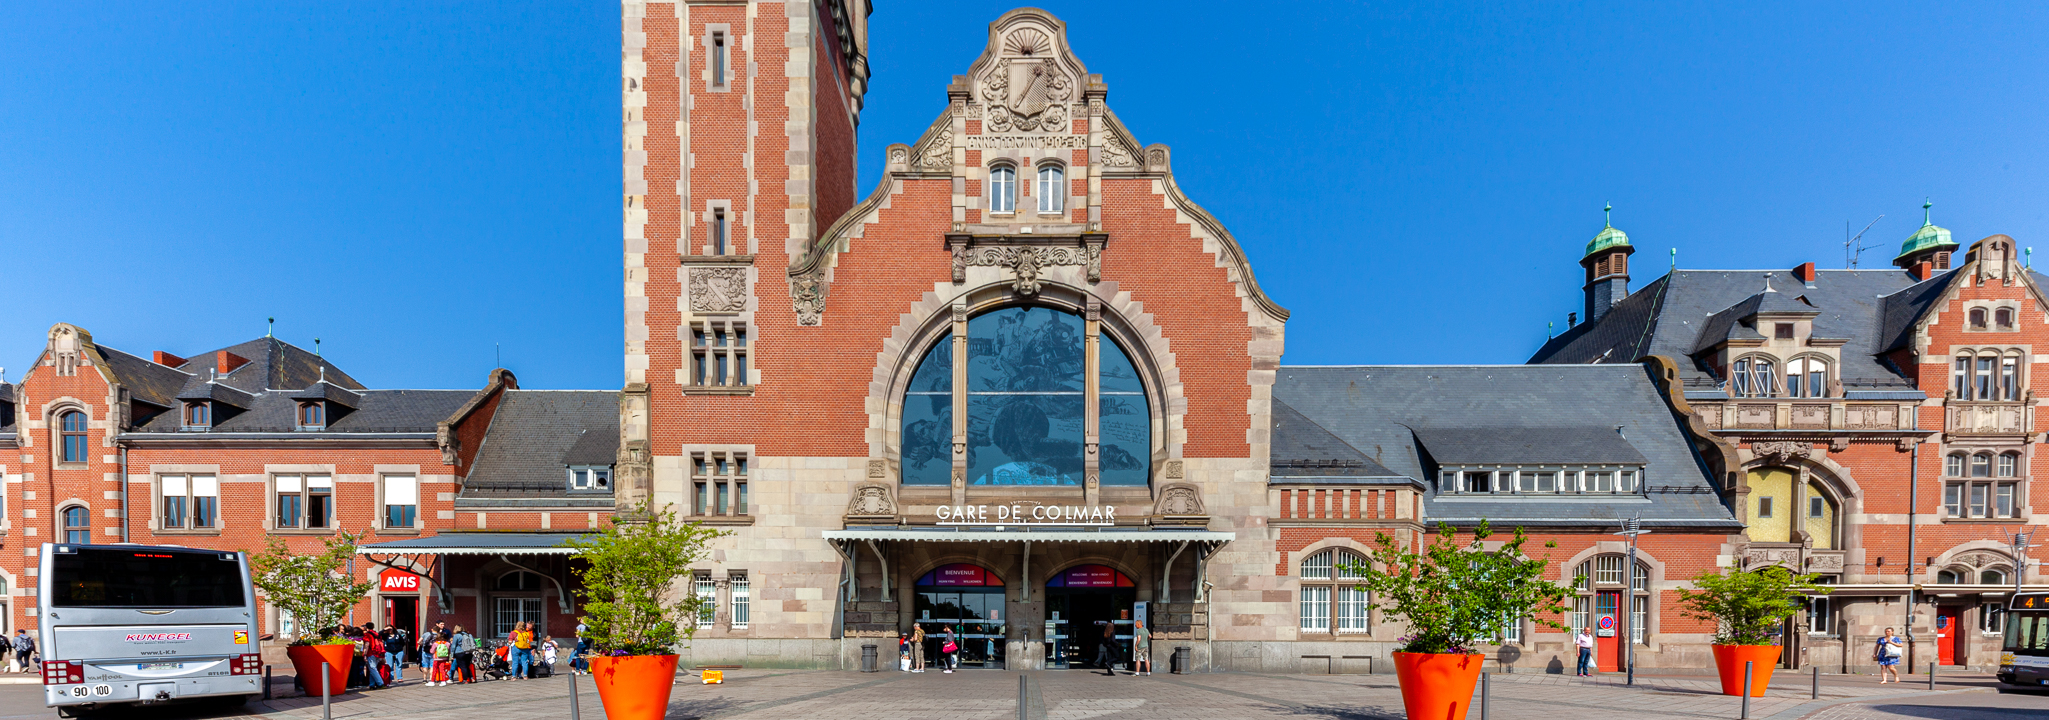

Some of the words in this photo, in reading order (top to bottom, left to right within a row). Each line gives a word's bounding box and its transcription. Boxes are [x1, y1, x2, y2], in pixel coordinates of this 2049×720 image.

[936, 505, 987, 520] GARE
[998, 505, 1021, 520] DE
[1032, 505, 1115, 520] COLMAR
[385, 576, 417, 588] AVIS
[2025, 597, 2034, 608] 4
[125, 633, 193, 642] KUNEGEL
[73, 686, 88, 697] 90
[95, 685, 110, 695] 100
